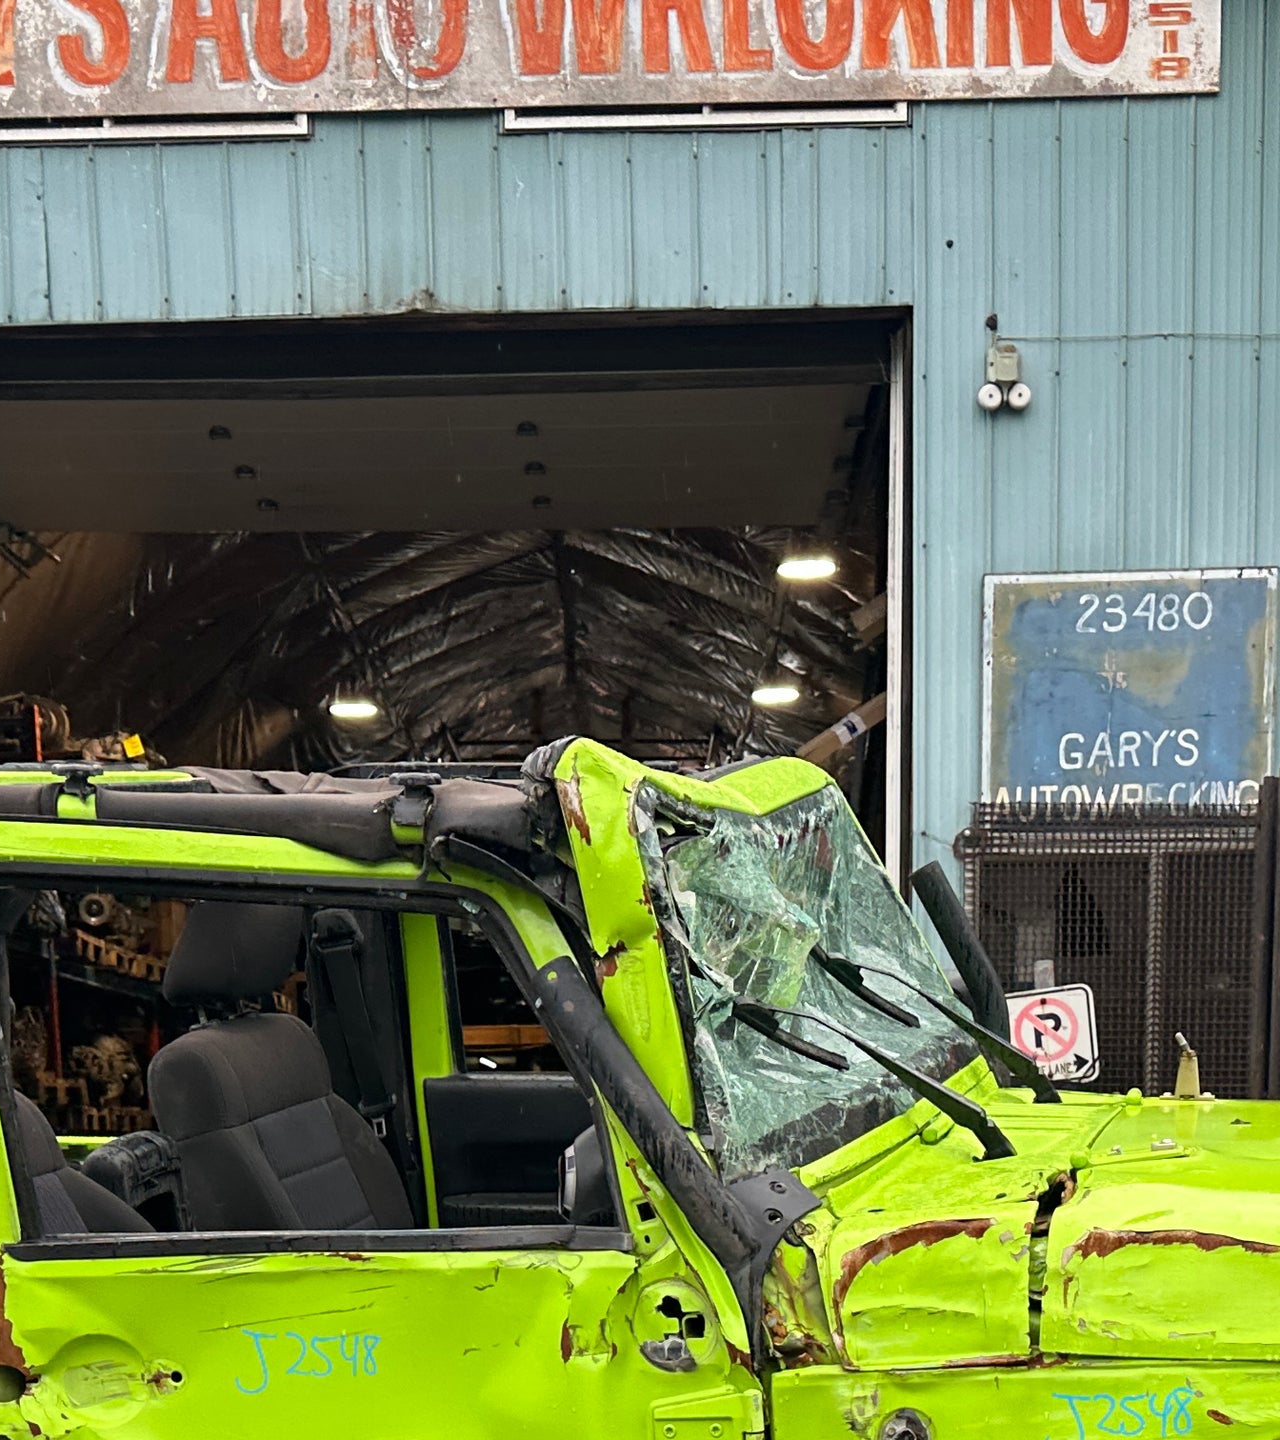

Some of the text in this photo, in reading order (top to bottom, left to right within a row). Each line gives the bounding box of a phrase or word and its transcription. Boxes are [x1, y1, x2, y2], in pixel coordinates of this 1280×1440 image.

[1075, 591, 1215, 634] 23480
[1058, 728, 1200, 771] GARY'S
[234, 1328, 382, 1395] J2548
